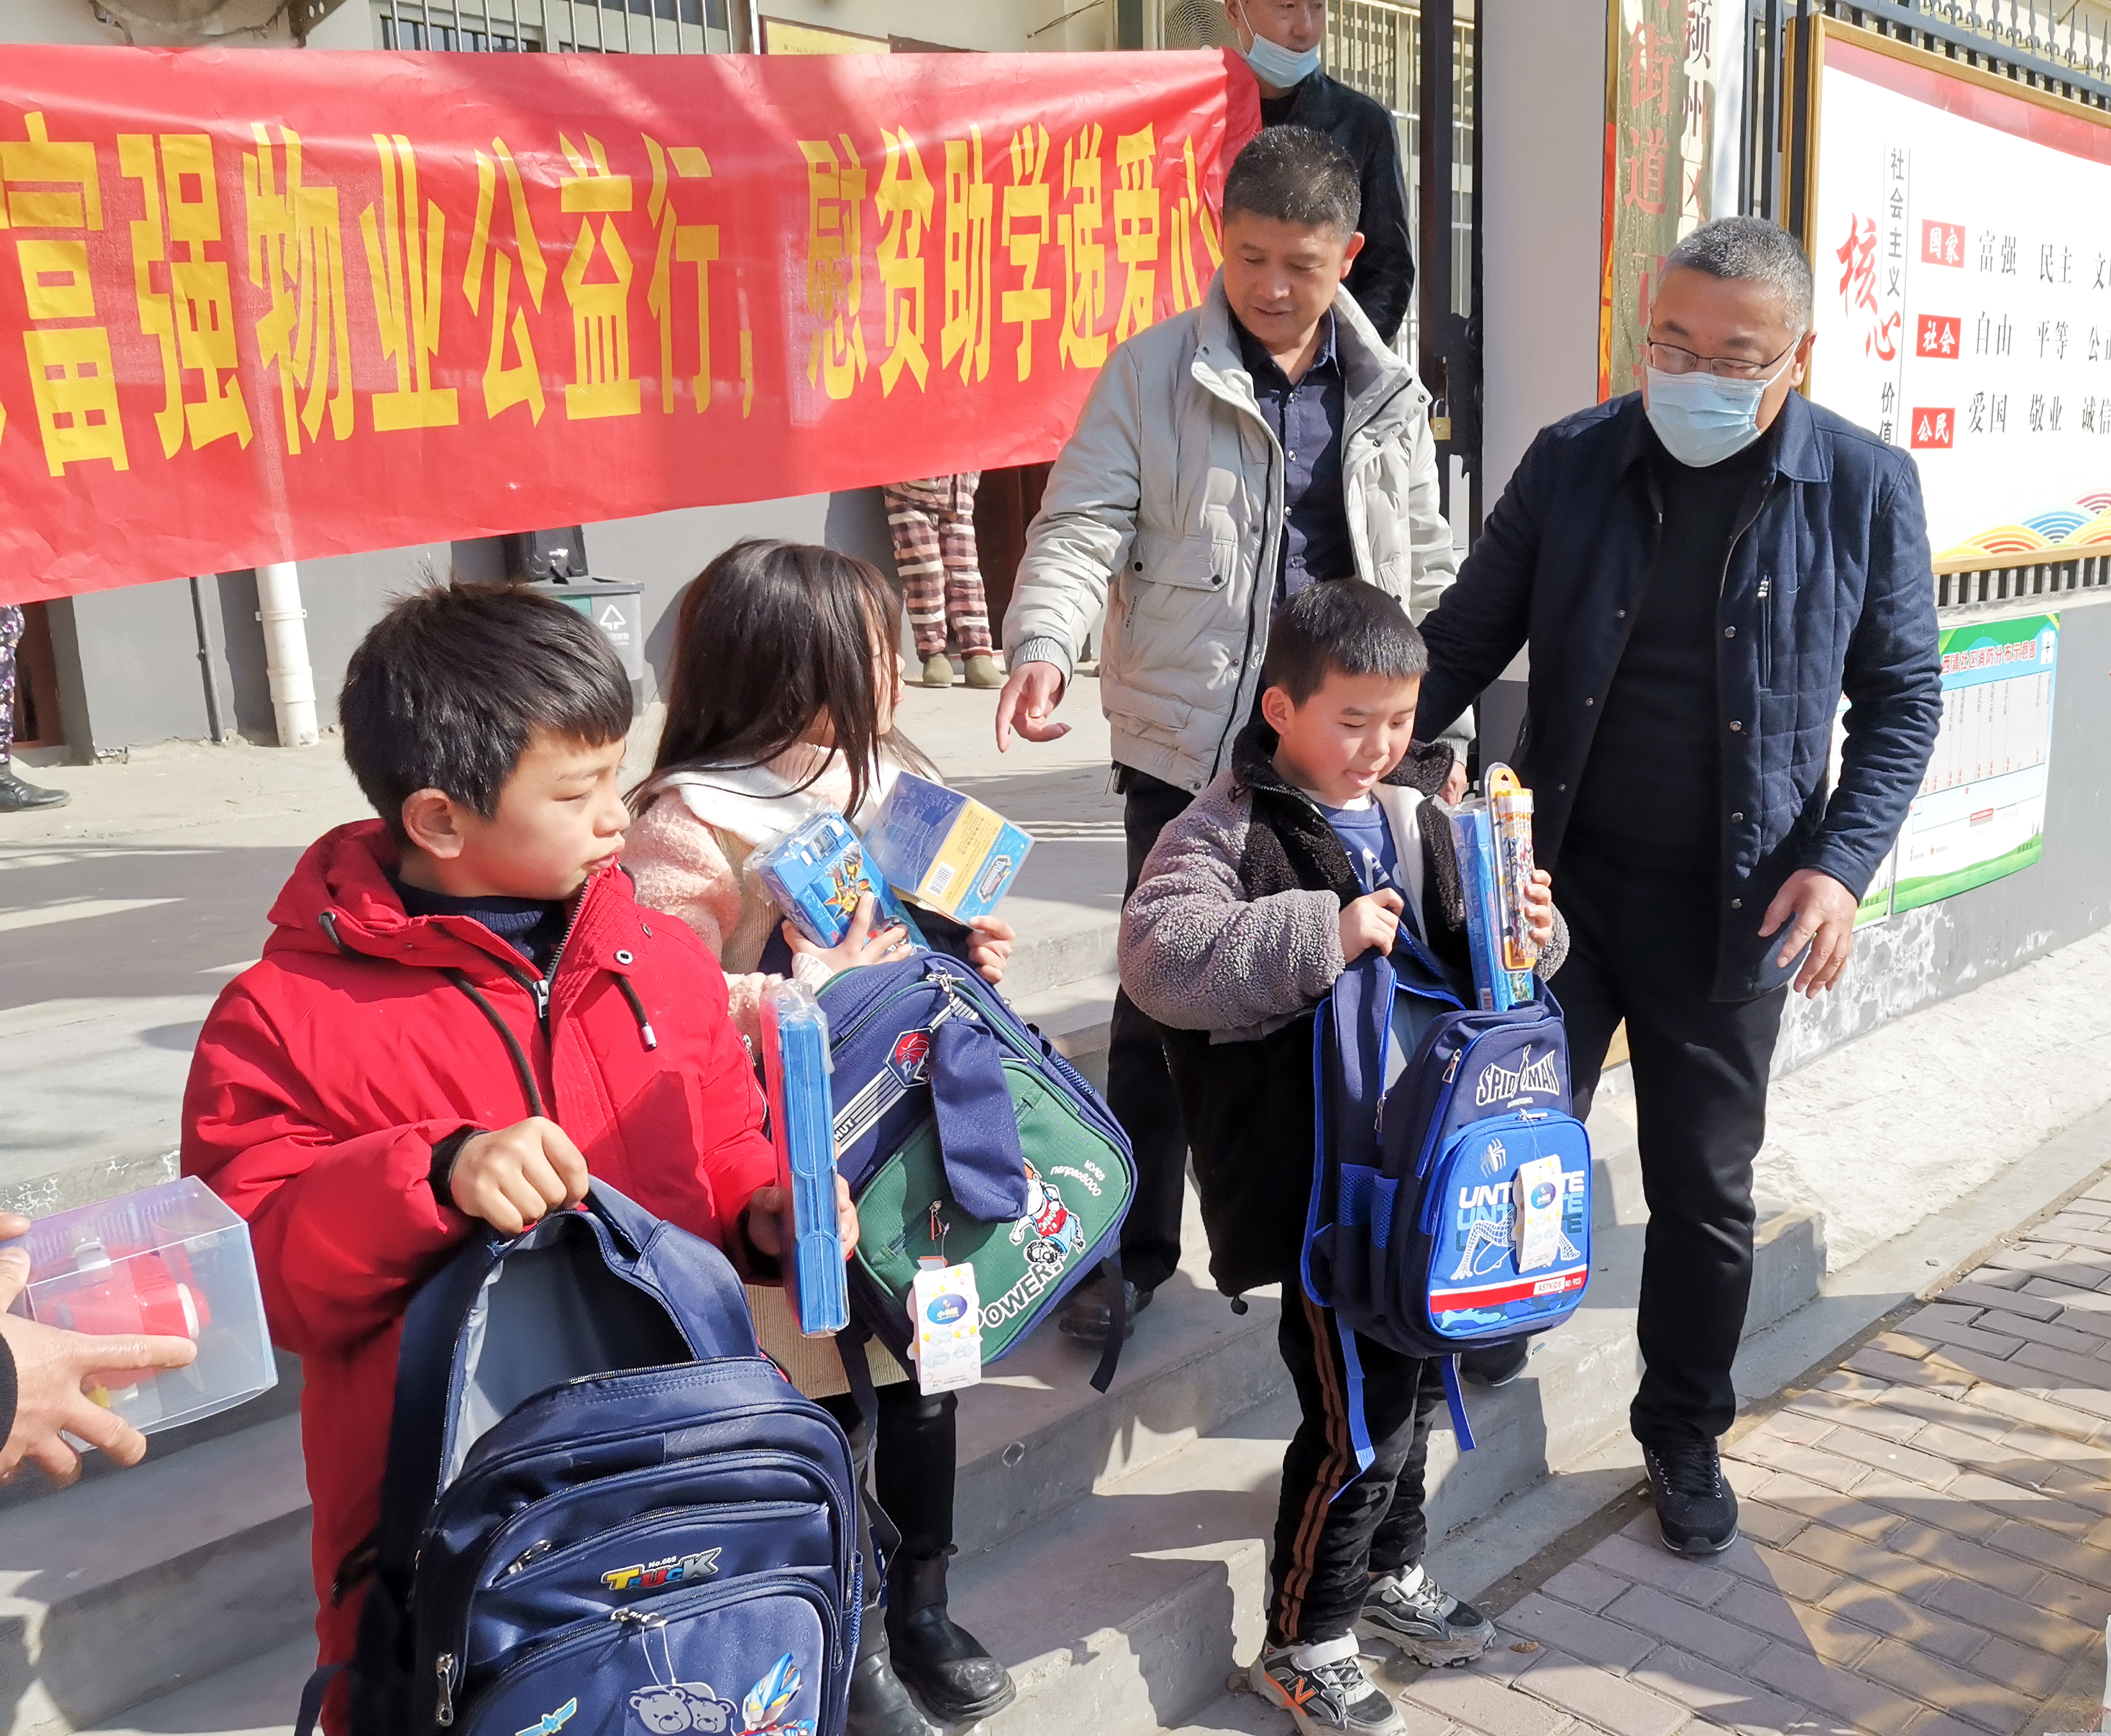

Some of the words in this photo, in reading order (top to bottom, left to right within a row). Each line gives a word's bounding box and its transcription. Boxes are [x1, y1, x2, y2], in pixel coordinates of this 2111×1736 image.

[1887, 147, 1904, 298] 社会主义
[1929, 226, 1961, 264] 国家
[1979, 229, 2017, 276] 富强
[2039, 243, 2072, 284] 民主
[2091, 252, 2111, 293] 文
[0, 111, 1224, 476] 富强物业公益行，慰贫助学递爱心
[1836, 212, 1901, 362] 核心
[1922, 320, 1955, 355] 社会
[1976, 311, 2012, 357] 自由
[2035, 319, 2069, 360] 平等
[1916, 411, 1950, 444] 公民
[1968, 390, 2008, 434] 爱国
[2028, 393, 2062, 433] 敬业
[2082, 396, 2111, 435] 诚信
[1538, 1280, 1562, 1292] XSTKIDS
